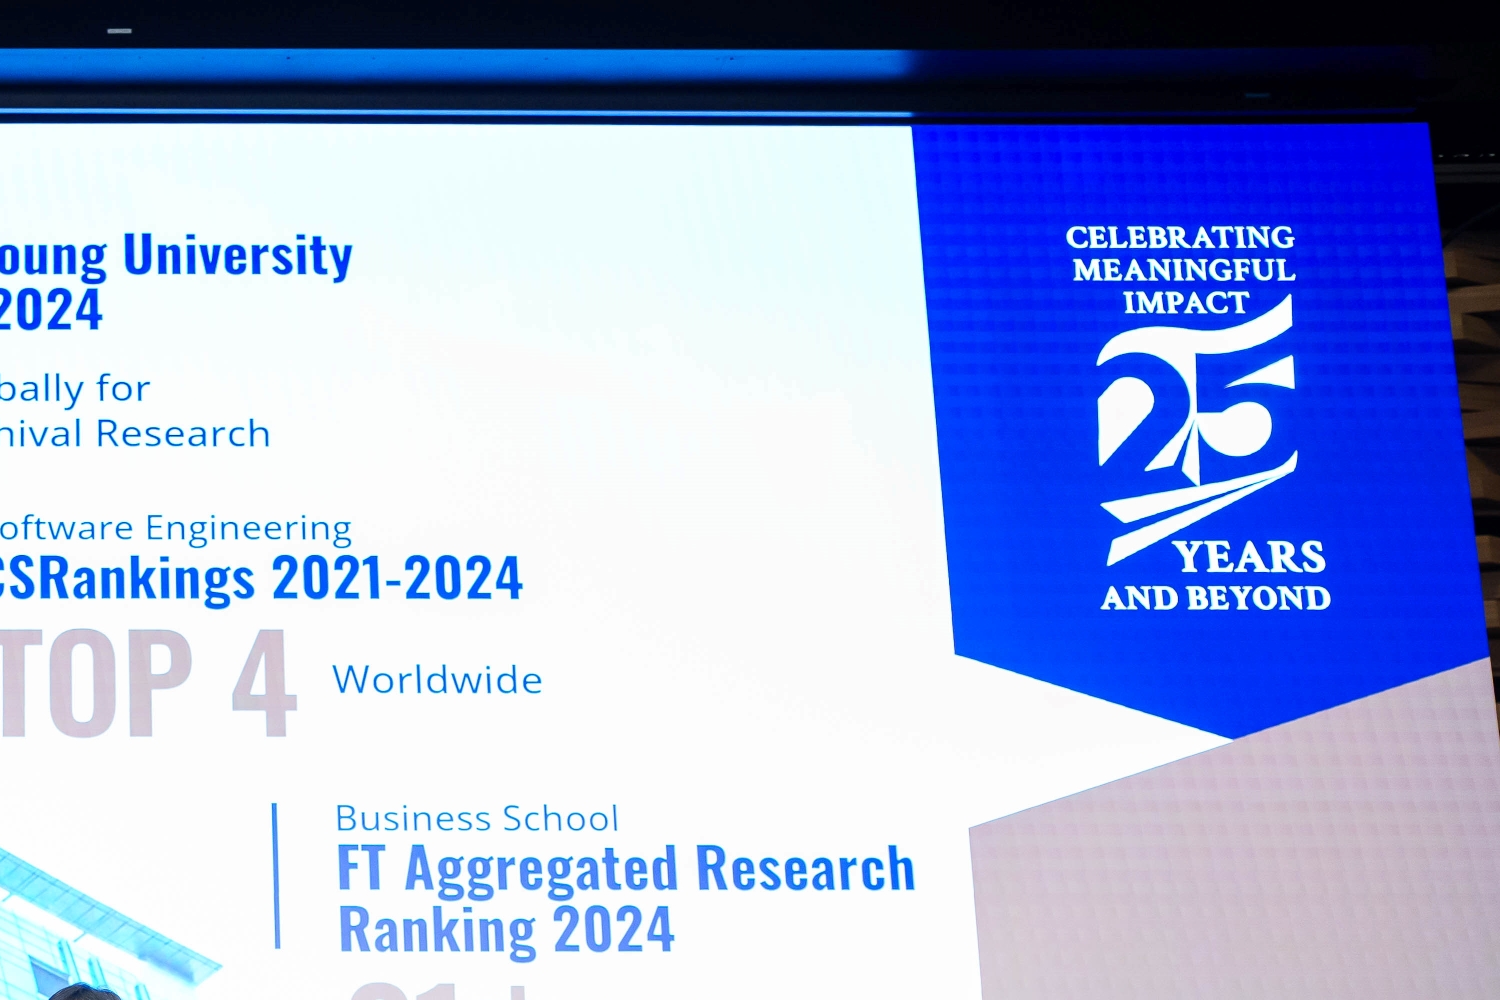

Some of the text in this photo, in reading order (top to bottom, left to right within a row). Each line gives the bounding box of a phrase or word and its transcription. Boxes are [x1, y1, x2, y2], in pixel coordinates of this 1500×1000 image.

[1066, 226, 1295, 249] CELEBRATING
[124, 232, 353, 283] University
[1073, 258, 1296, 282] MEANINGFUL
[1124, 291, 1250, 314] IMPACT
[96, 373, 150, 403] for
[1097, 294, 1298, 495] 25
[98, 420, 270, 448] Research
[148, 514, 351, 547] Engineering
[1172, 540, 1326, 573] YEARS
[272, 554, 522, 600] 2021-2024
[1100, 586, 1331, 610] AND BEYOND
[232, 629, 297, 738] 4
[332, 664, 542, 696] Worldwide
[336, 804, 618, 832] Business School
[338, 843, 914, 901] FT Aggregated Research
[340, 905, 674, 963] Ranking 2024
